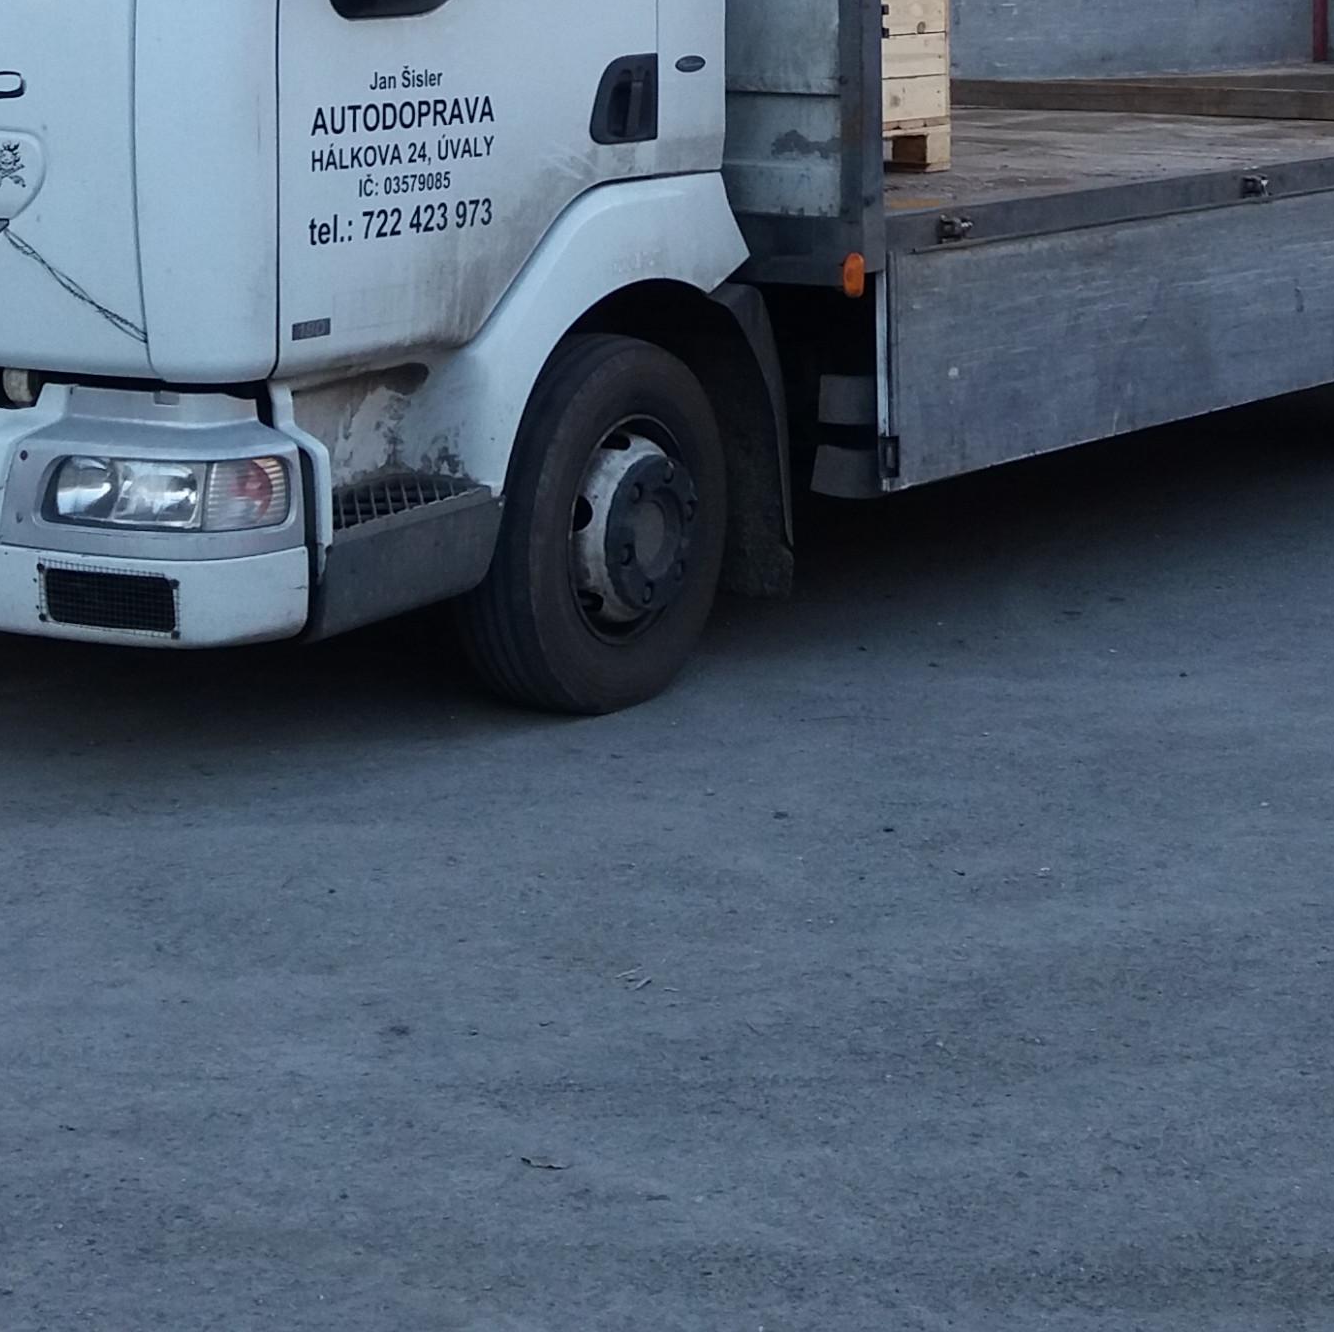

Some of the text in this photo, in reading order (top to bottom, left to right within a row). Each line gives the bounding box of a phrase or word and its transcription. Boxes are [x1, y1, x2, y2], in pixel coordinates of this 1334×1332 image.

[369, 65, 444, 91] Jan Šisler
[310, 95, 495, 137] AUTODOPRAVA
[311, 134, 495, 172] HÁLKOVA 24, ÚVALY
[358, 171, 452, 198] IČ: 03579085
[309, 197, 493, 246] tel.: 722 423 973
